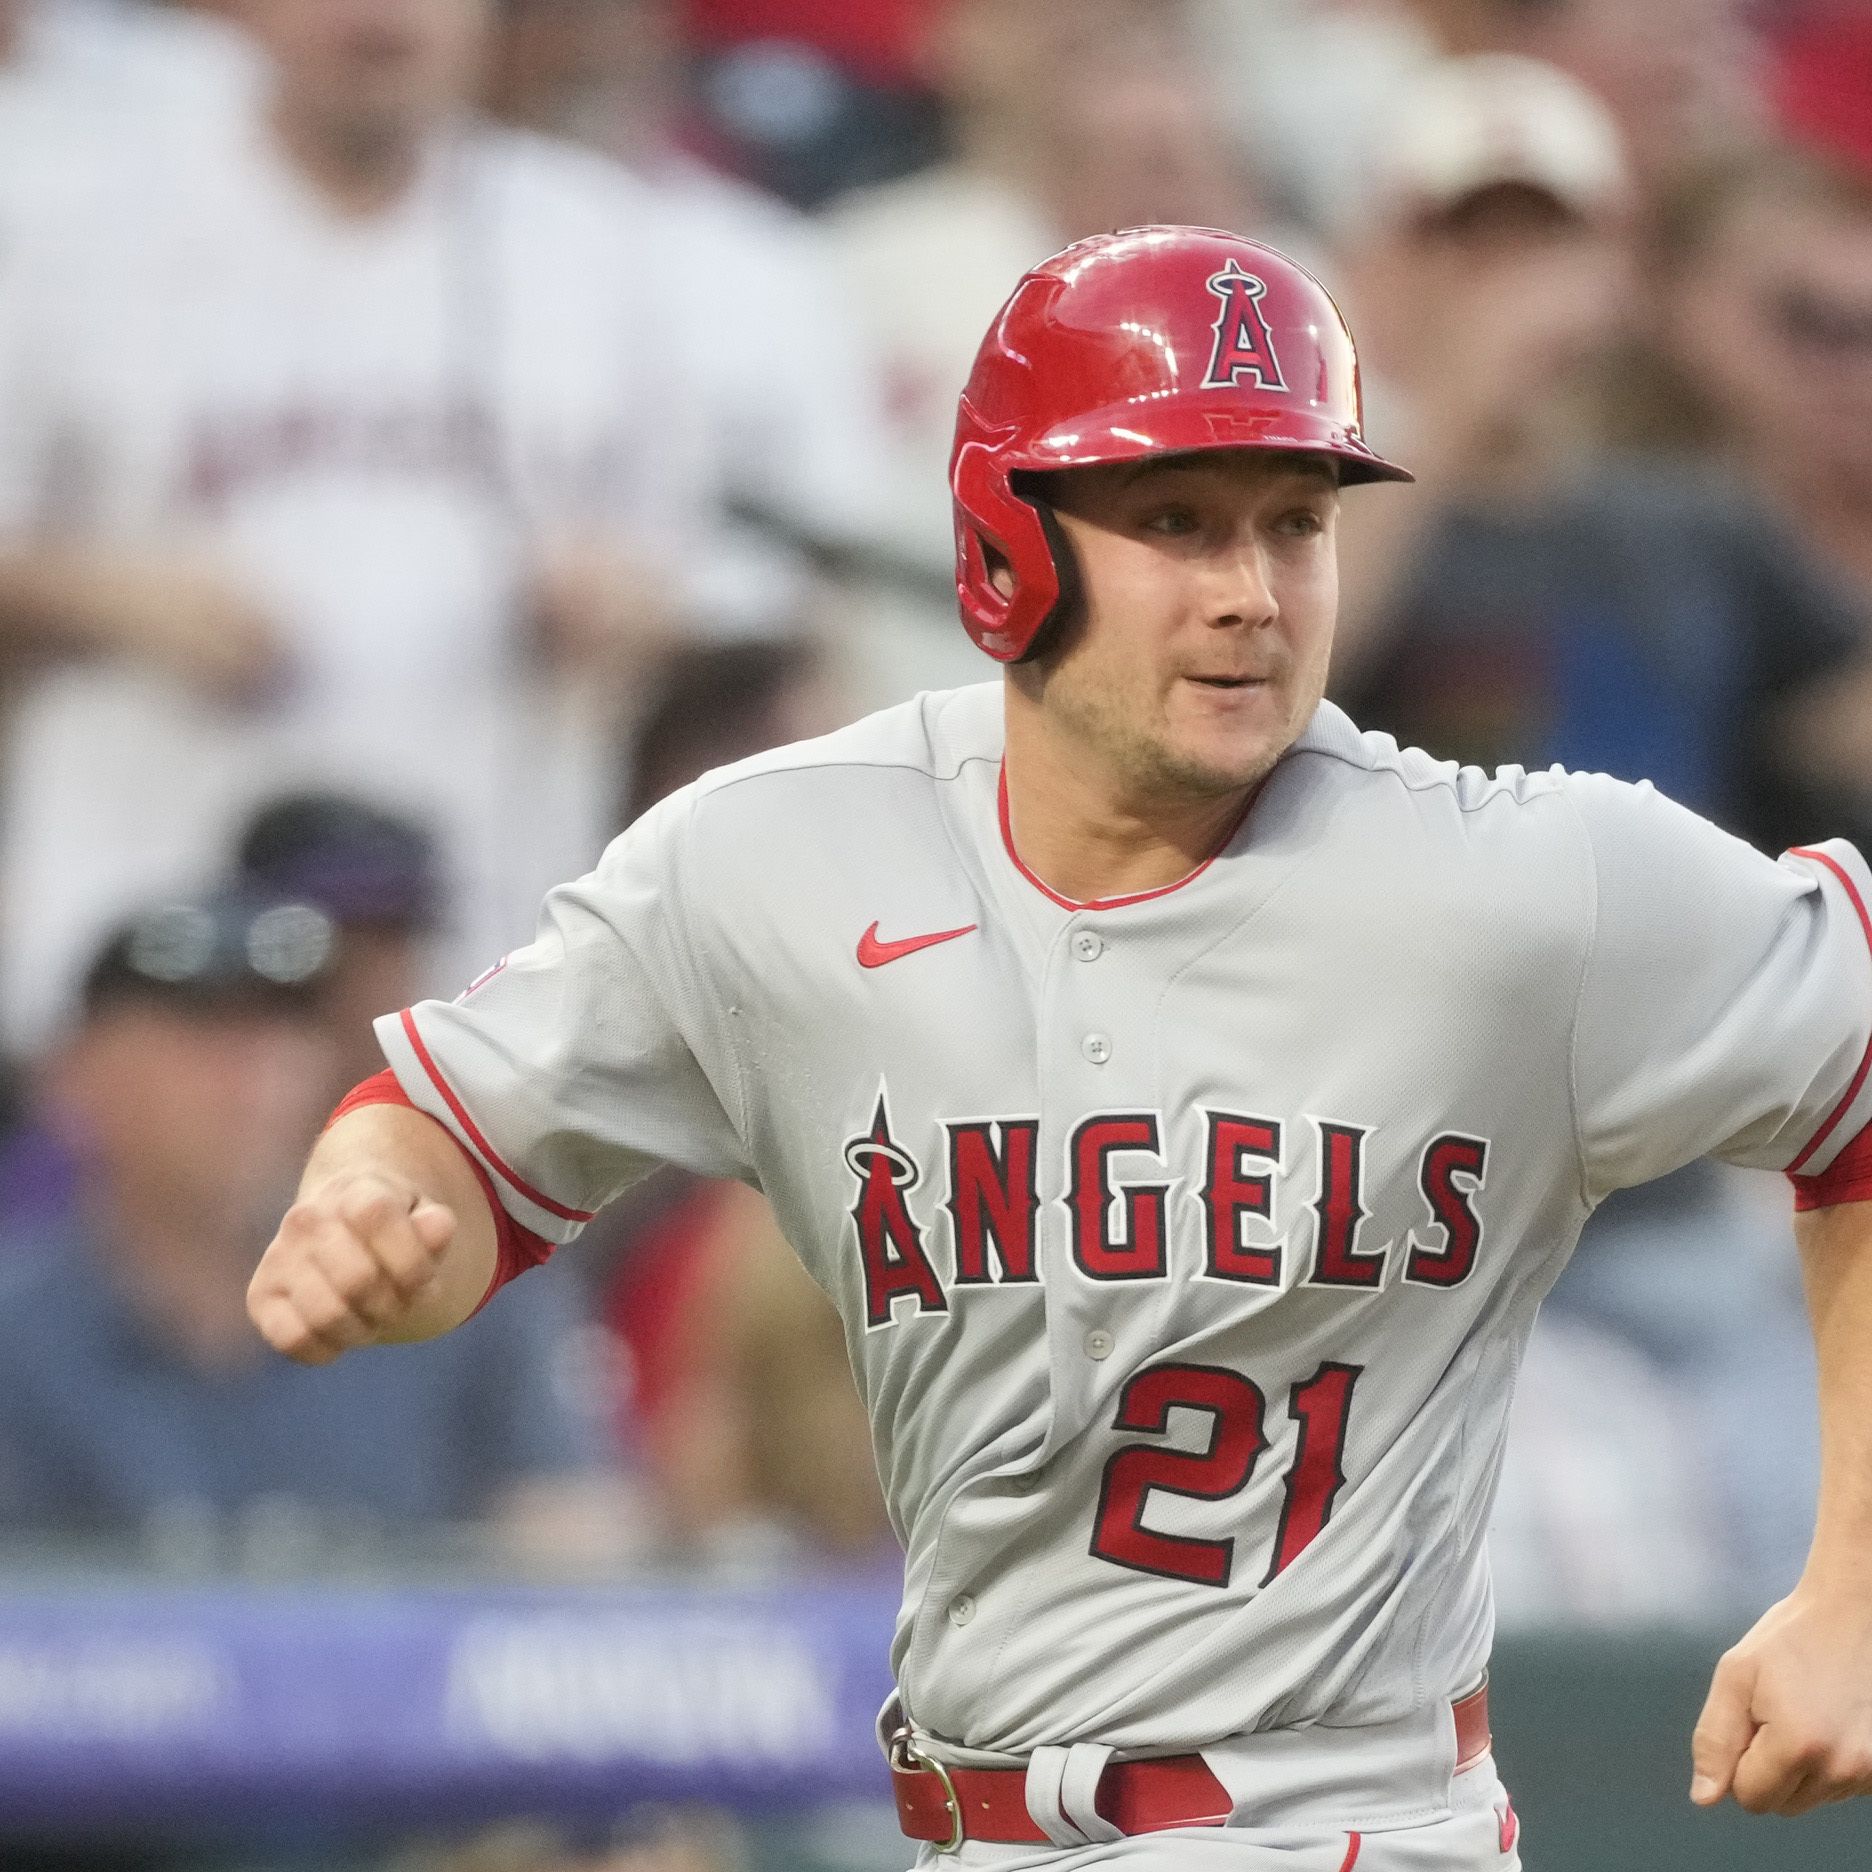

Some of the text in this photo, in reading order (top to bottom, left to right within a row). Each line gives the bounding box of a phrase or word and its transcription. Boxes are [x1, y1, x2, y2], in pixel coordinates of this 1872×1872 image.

[1200, 258, 1290, 393] A
[844, 1072, 1492, 1334] ANGELS
[1088, 1360, 1365, 1588] 21
